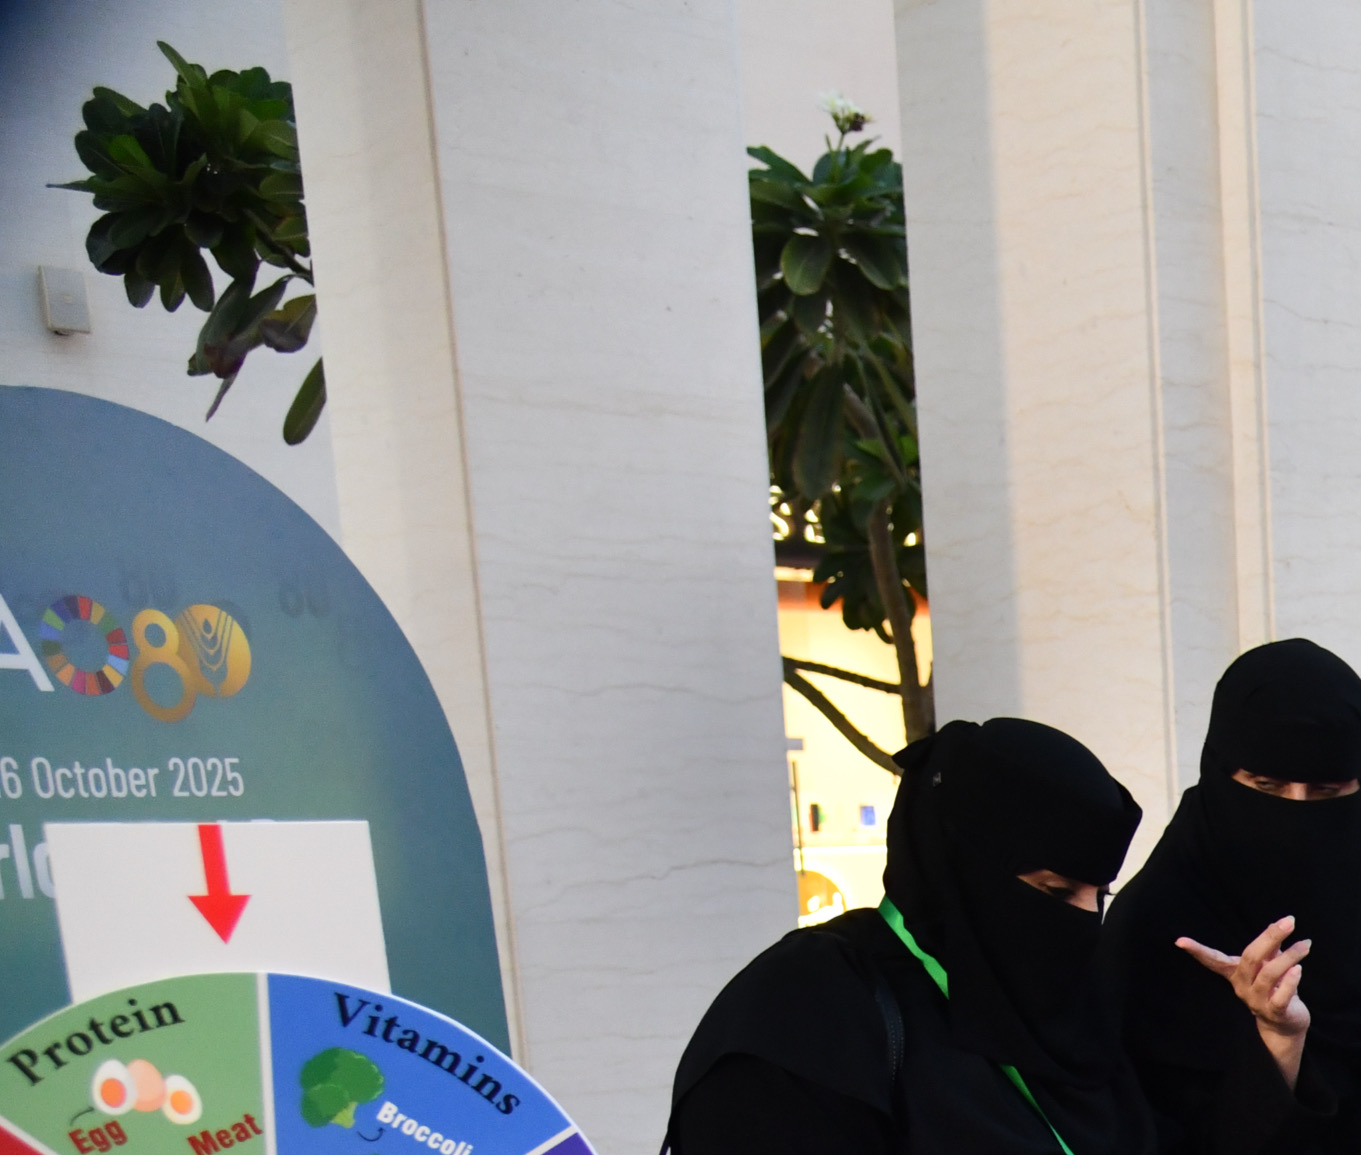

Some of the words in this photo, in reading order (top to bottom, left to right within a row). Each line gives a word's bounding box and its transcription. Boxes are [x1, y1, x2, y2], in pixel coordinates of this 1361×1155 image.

[0, 757, 23, 799] 6
[31, 757, 160, 799] October
[167, 757, 245, 798] 2025
[7, 993, 186, 1088] Protein
[332, 991, 524, 1116] Vitamins
[68, 1120, 128, 1155] Egg
